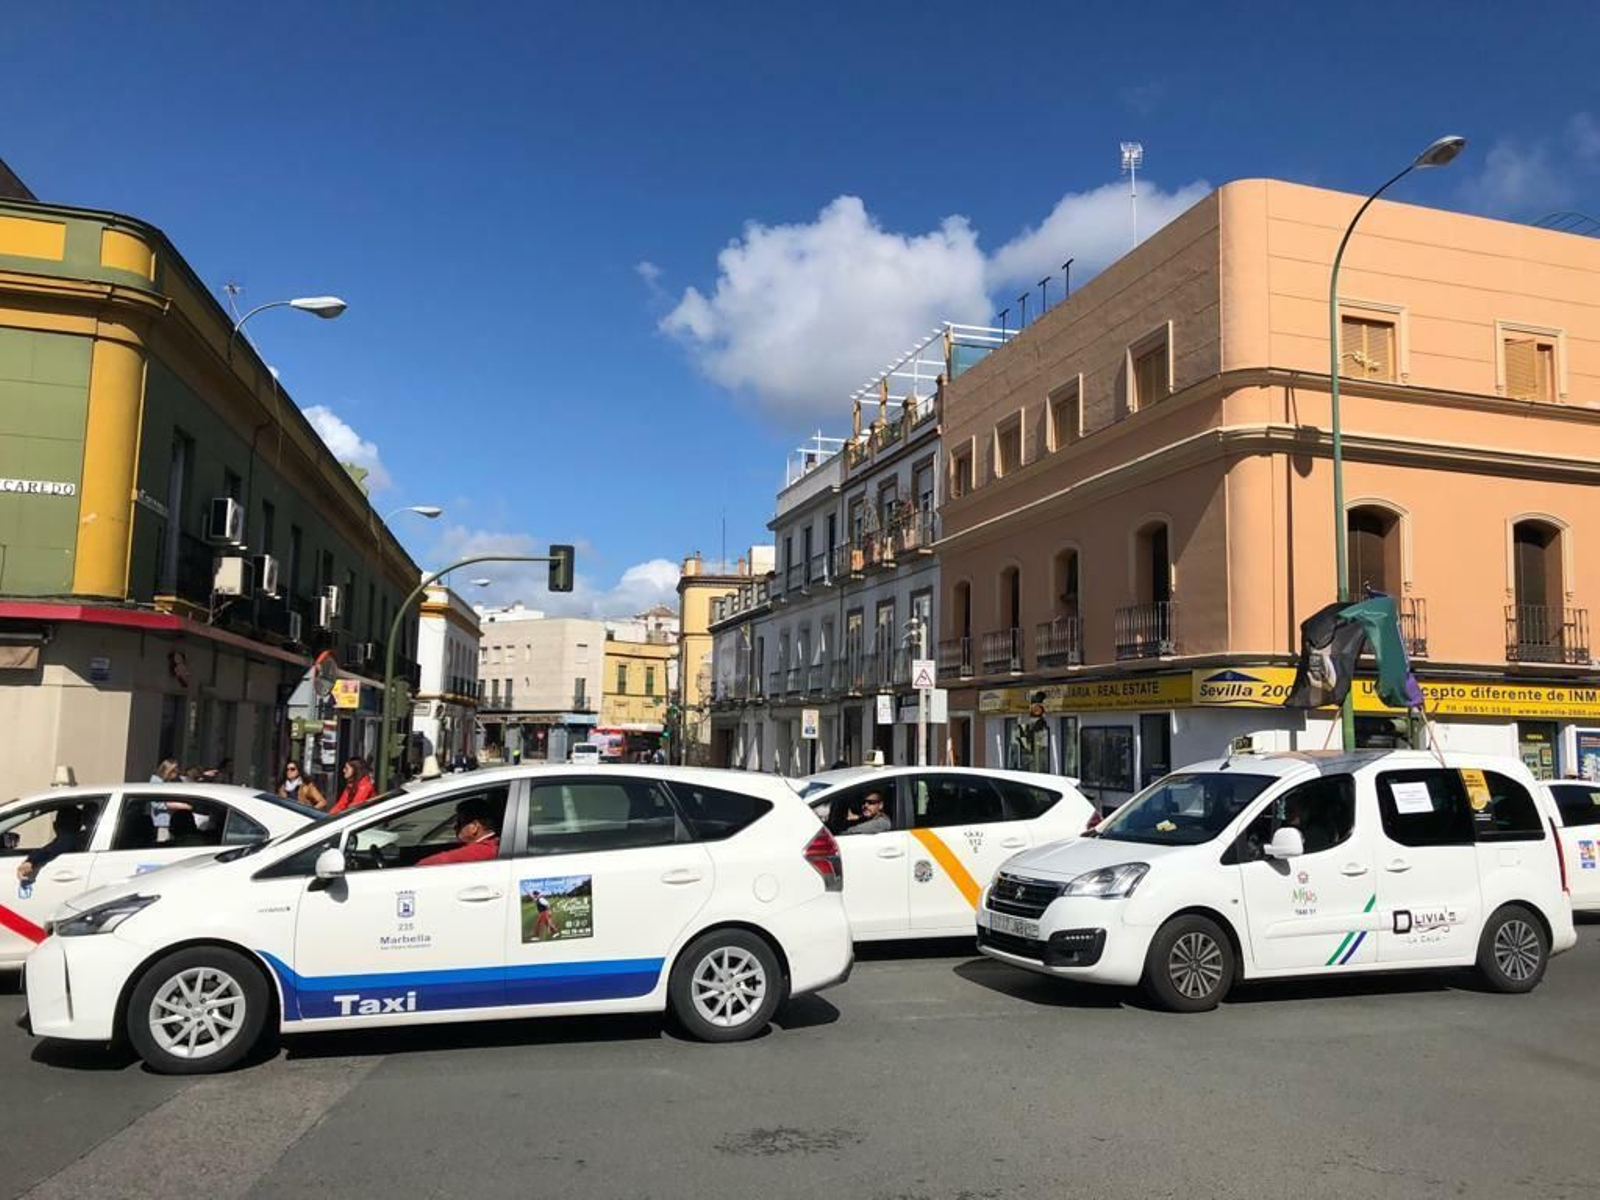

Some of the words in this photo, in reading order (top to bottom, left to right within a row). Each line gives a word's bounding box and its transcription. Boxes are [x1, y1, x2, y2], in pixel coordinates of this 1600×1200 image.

[3, 480, 74, 496] CAREDO
[1097, 683, 1121, 696] REAL
[1122, 681, 1159, 696] ESTATE
[1199, 684, 1253, 697] Sevilla
[1261, 684, 1293, 697] 200
[1422, 687, 1466, 700] cepto
[1471, 687, 1541, 701] diferente
[1546, 689, 1565, 701] de
[1569, 689, 1600, 702] INM
[379, 933, 431, 944] Marbella
[333, 990, 417, 1016] Taxi
